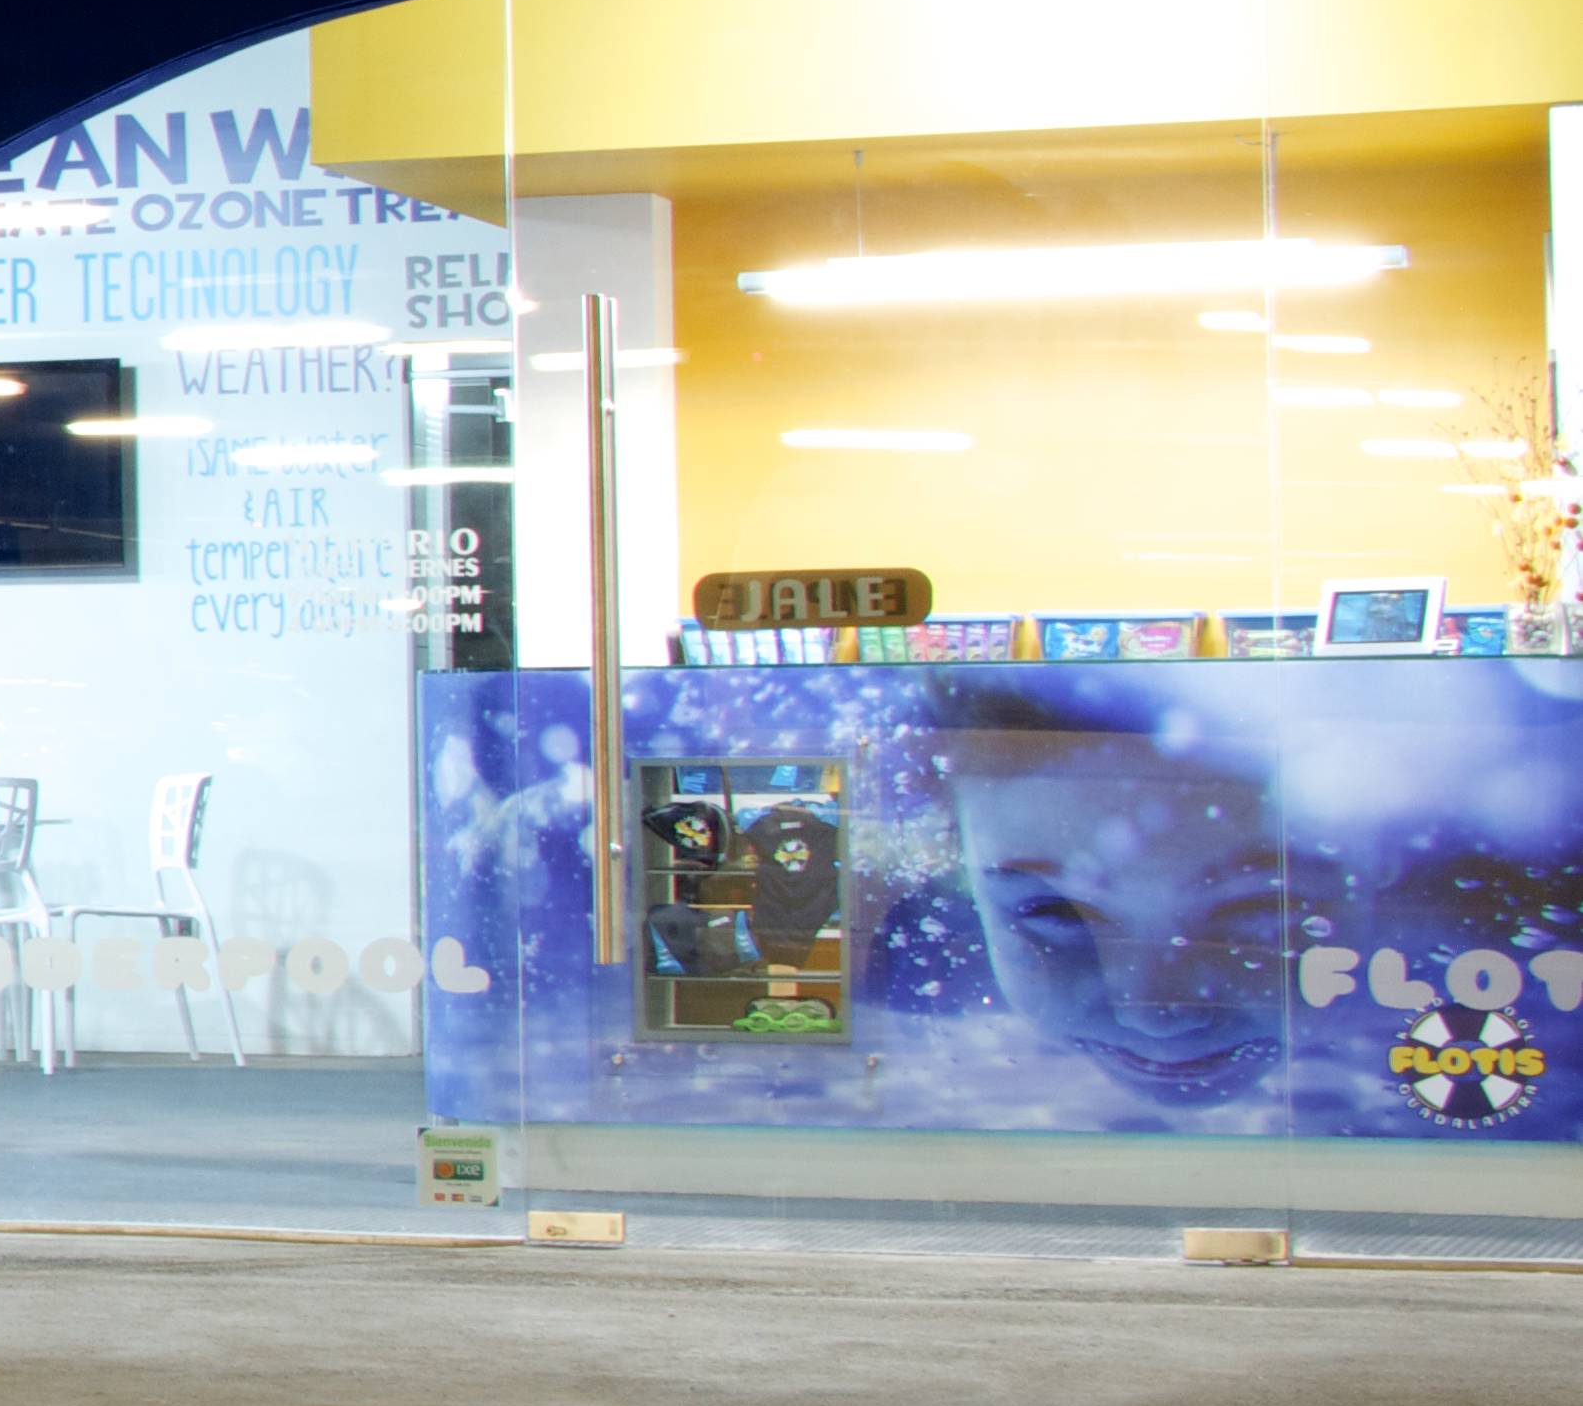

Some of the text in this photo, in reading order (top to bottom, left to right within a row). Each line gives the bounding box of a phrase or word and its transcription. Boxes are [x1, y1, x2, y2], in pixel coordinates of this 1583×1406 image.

[131, 188, 326, 232] OZONE
[335, 187, 459, 225] TRE
[74, 244, 359, 324] TECHNOLOGY
[191, 591, 285, 638] every
[1388, 1046, 1546, 1077] FLOTIS
